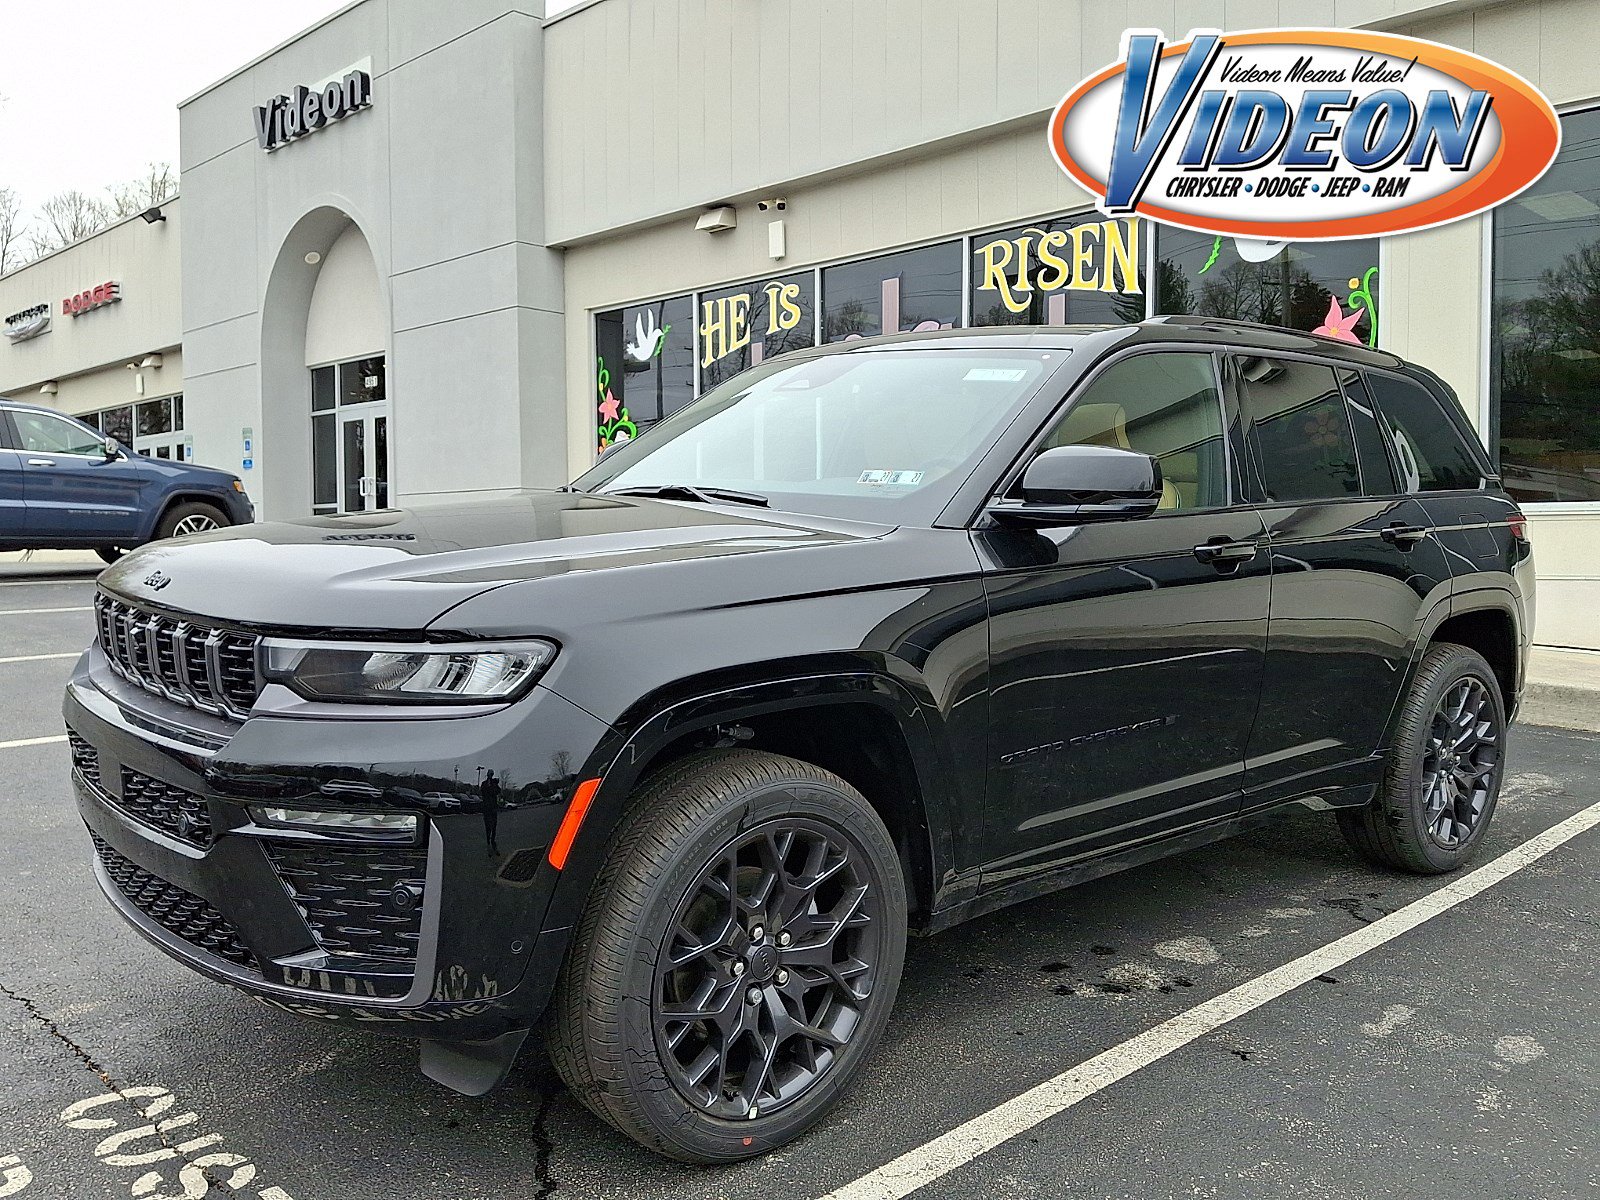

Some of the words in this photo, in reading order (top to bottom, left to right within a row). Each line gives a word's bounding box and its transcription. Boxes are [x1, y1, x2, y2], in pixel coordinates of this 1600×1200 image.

[252, 69, 371, 150] Videon
[62, 281, 119, 315] DODGE
[974, 217, 1140, 314] RISEN
[700, 292, 751, 369] HE
[763, 281, 801, 335] IS
[143, 570, 172, 592] Jeep
[60, 1086, 292, 1200] CUS
